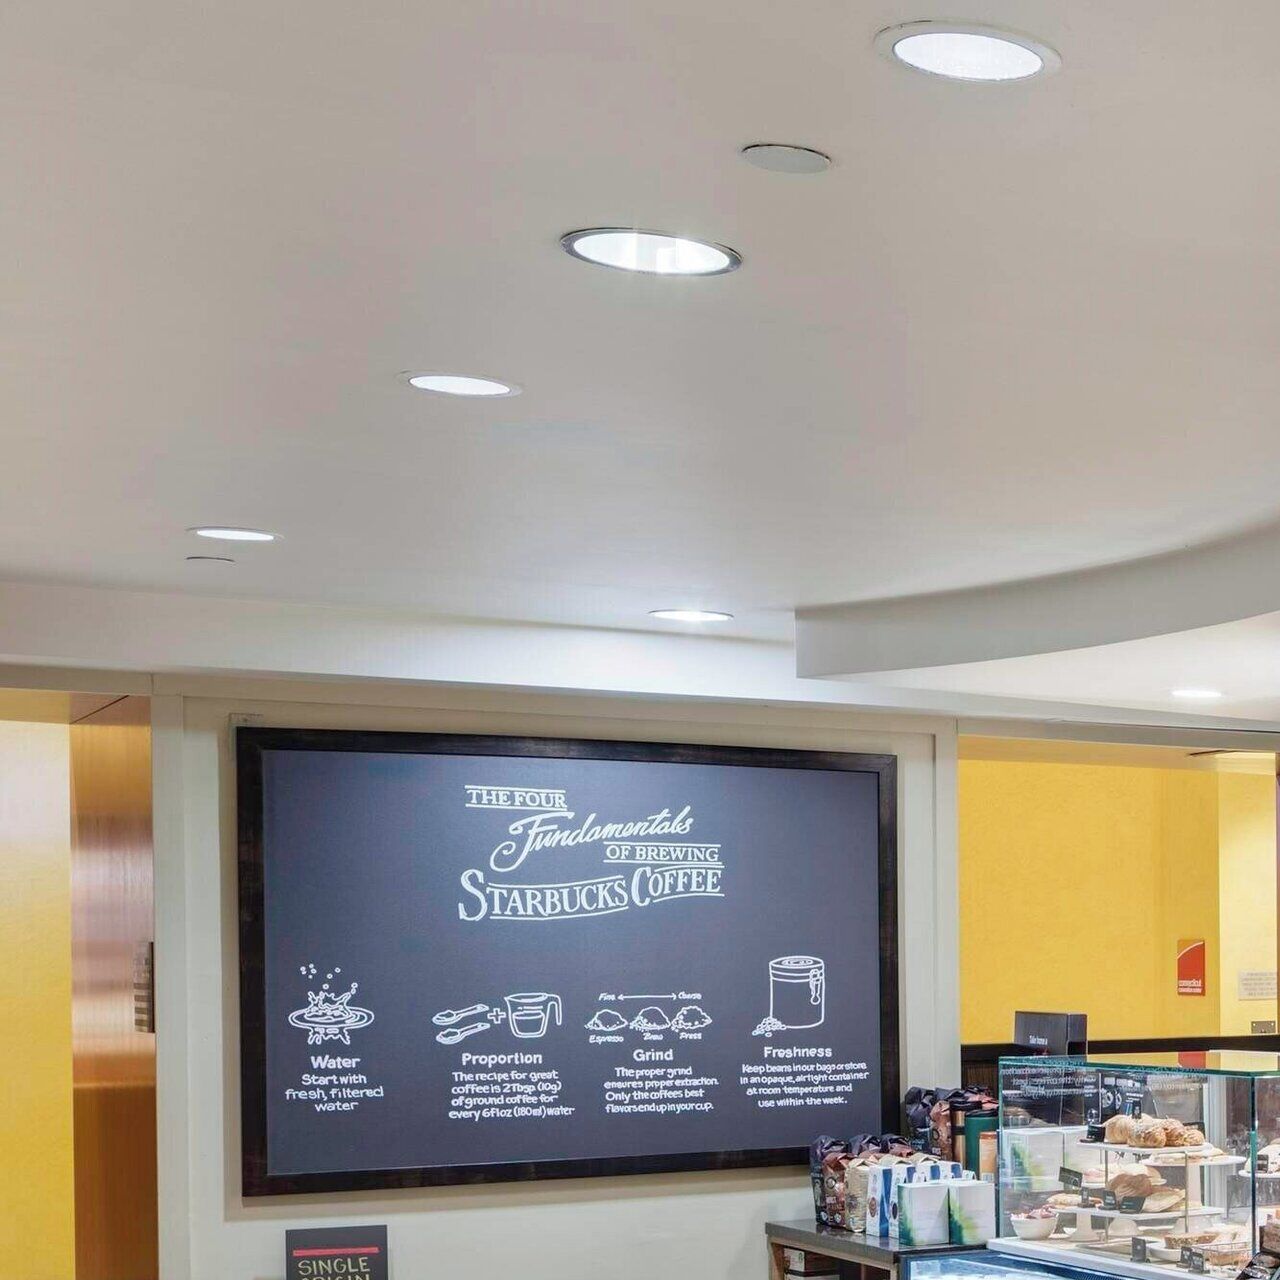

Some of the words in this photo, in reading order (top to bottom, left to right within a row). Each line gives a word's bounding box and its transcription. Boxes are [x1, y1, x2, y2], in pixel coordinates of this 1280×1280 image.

[467, 789, 511, 805] THE
[515, 792, 567, 808] FOUR
[490, 806, 693, 871] Fundamentals
[606, 846, 629, 859] OF
[636, 846, 719, 861] BREWING
[459, 869, 628, 921] STARBUCKS
[632, 867, 721, 906] COFFEE
[633, 1049, 673, 1061] Grind
[764, 1047, 832, 1058] Freshness
[311, 1056, 360, 1069] Water
[462, 1053, 543, 1068] Proportion
[615, 1067, 635, 1077] The
[636, 1068, 666, 1079] proper
[667, 1066, 692, 1078] grind
[742, 1064, 765, 1074] Keep
[766, 1064, 792, 1072] beans
[845, 1062, 867, 1070] store
[302, 1075, 337, 1086] Start
[340, 1075, 367, 1084] with
[452, 1072, 474, 1081] The
[476, 1072, 509, 1082] recipe
[510, 1071, 527, 1079] for
[529, 1071, 558, 1081] great
[828, 1072, 869, 1080] container
[451, 1084, 489, 1094] coffee
[491, 1084, 500, 1093] is
[604, 1081, 643, 1089] ensures
[645, 1081, 674, 1090] proper
[746, 1087, 758, 1096] at
[782, 1085, 834, 1095] temperature
[836, 1083, 852, 1092] and
[285, 1089, 327, 1100] fresh,
[330, 1087, 384, 1098] filtered
[605, 1092, 631, 1103] Only
[632, 1091, 649, 1100] the
[650, 1090, 683, 1099] coffees
[685, 1089, 704, 1098] best
[315, 1101, 359, 1112] water
[451, 1097, 463, 1107] of
[464, 1095, 504, 1109] ground
[506, 1096, 538, 1104] coffee
[540, 1094, 558, 1102] for
[776, 1098, 804, 1106] within
[805, 1097, 821, 1105] the
[449, 1109, 480, 1121] every
[547, 1106, 575, 1116] water
[605, 1104, 640, 1113] flavors
[640, 1104, 655, 1112] end
[657, 1105, 667, 1114] up
[676, 1104, 694, 1113] your
[298, 1257, 371, 1276] SINGLE
